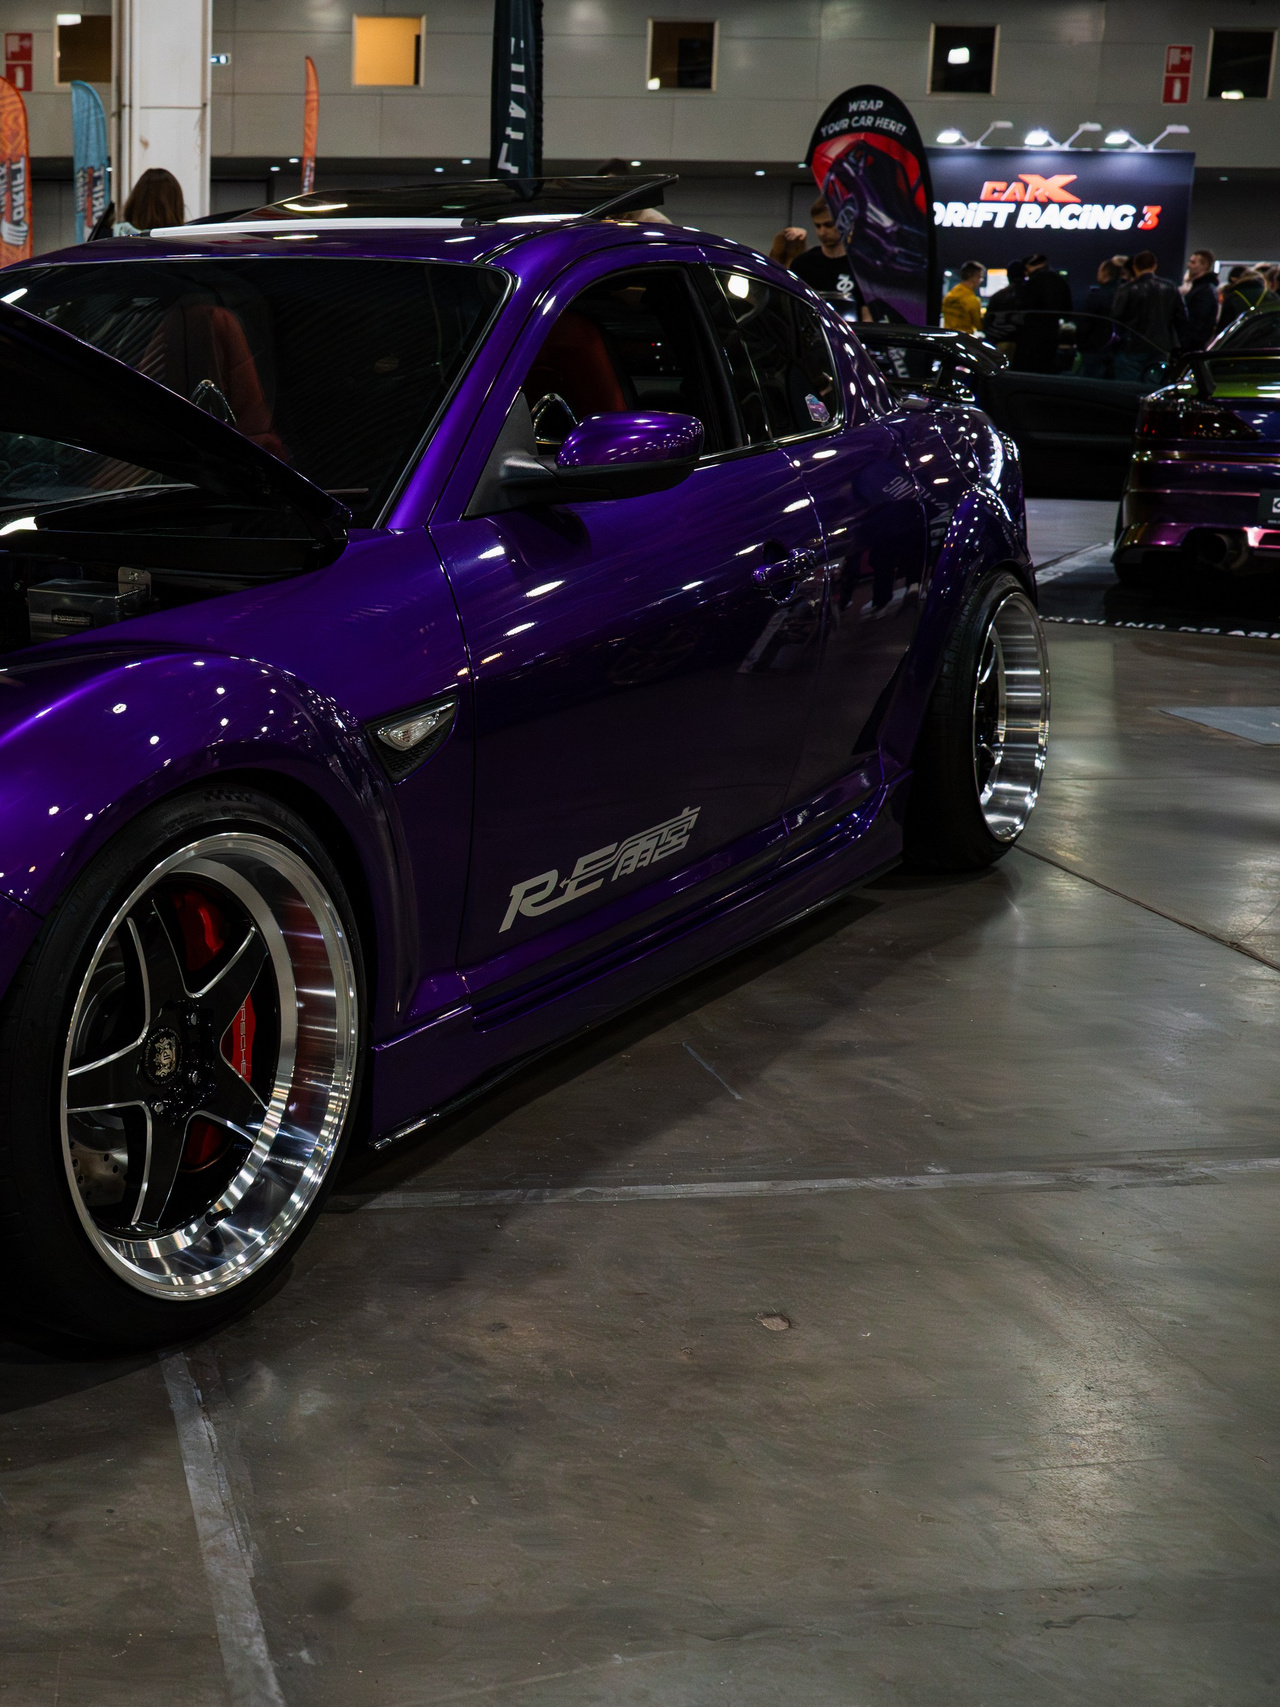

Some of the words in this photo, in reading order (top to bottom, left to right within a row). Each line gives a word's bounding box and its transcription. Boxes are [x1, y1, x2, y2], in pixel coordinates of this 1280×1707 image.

[848, 100, 884, 113] WRAP
[821, 118, 850, 137] YOUR
[850, 115, 875, 128] CAR
[874, 116, 908, 136] HERE!
[1137, 205, 1162, 231] 3
